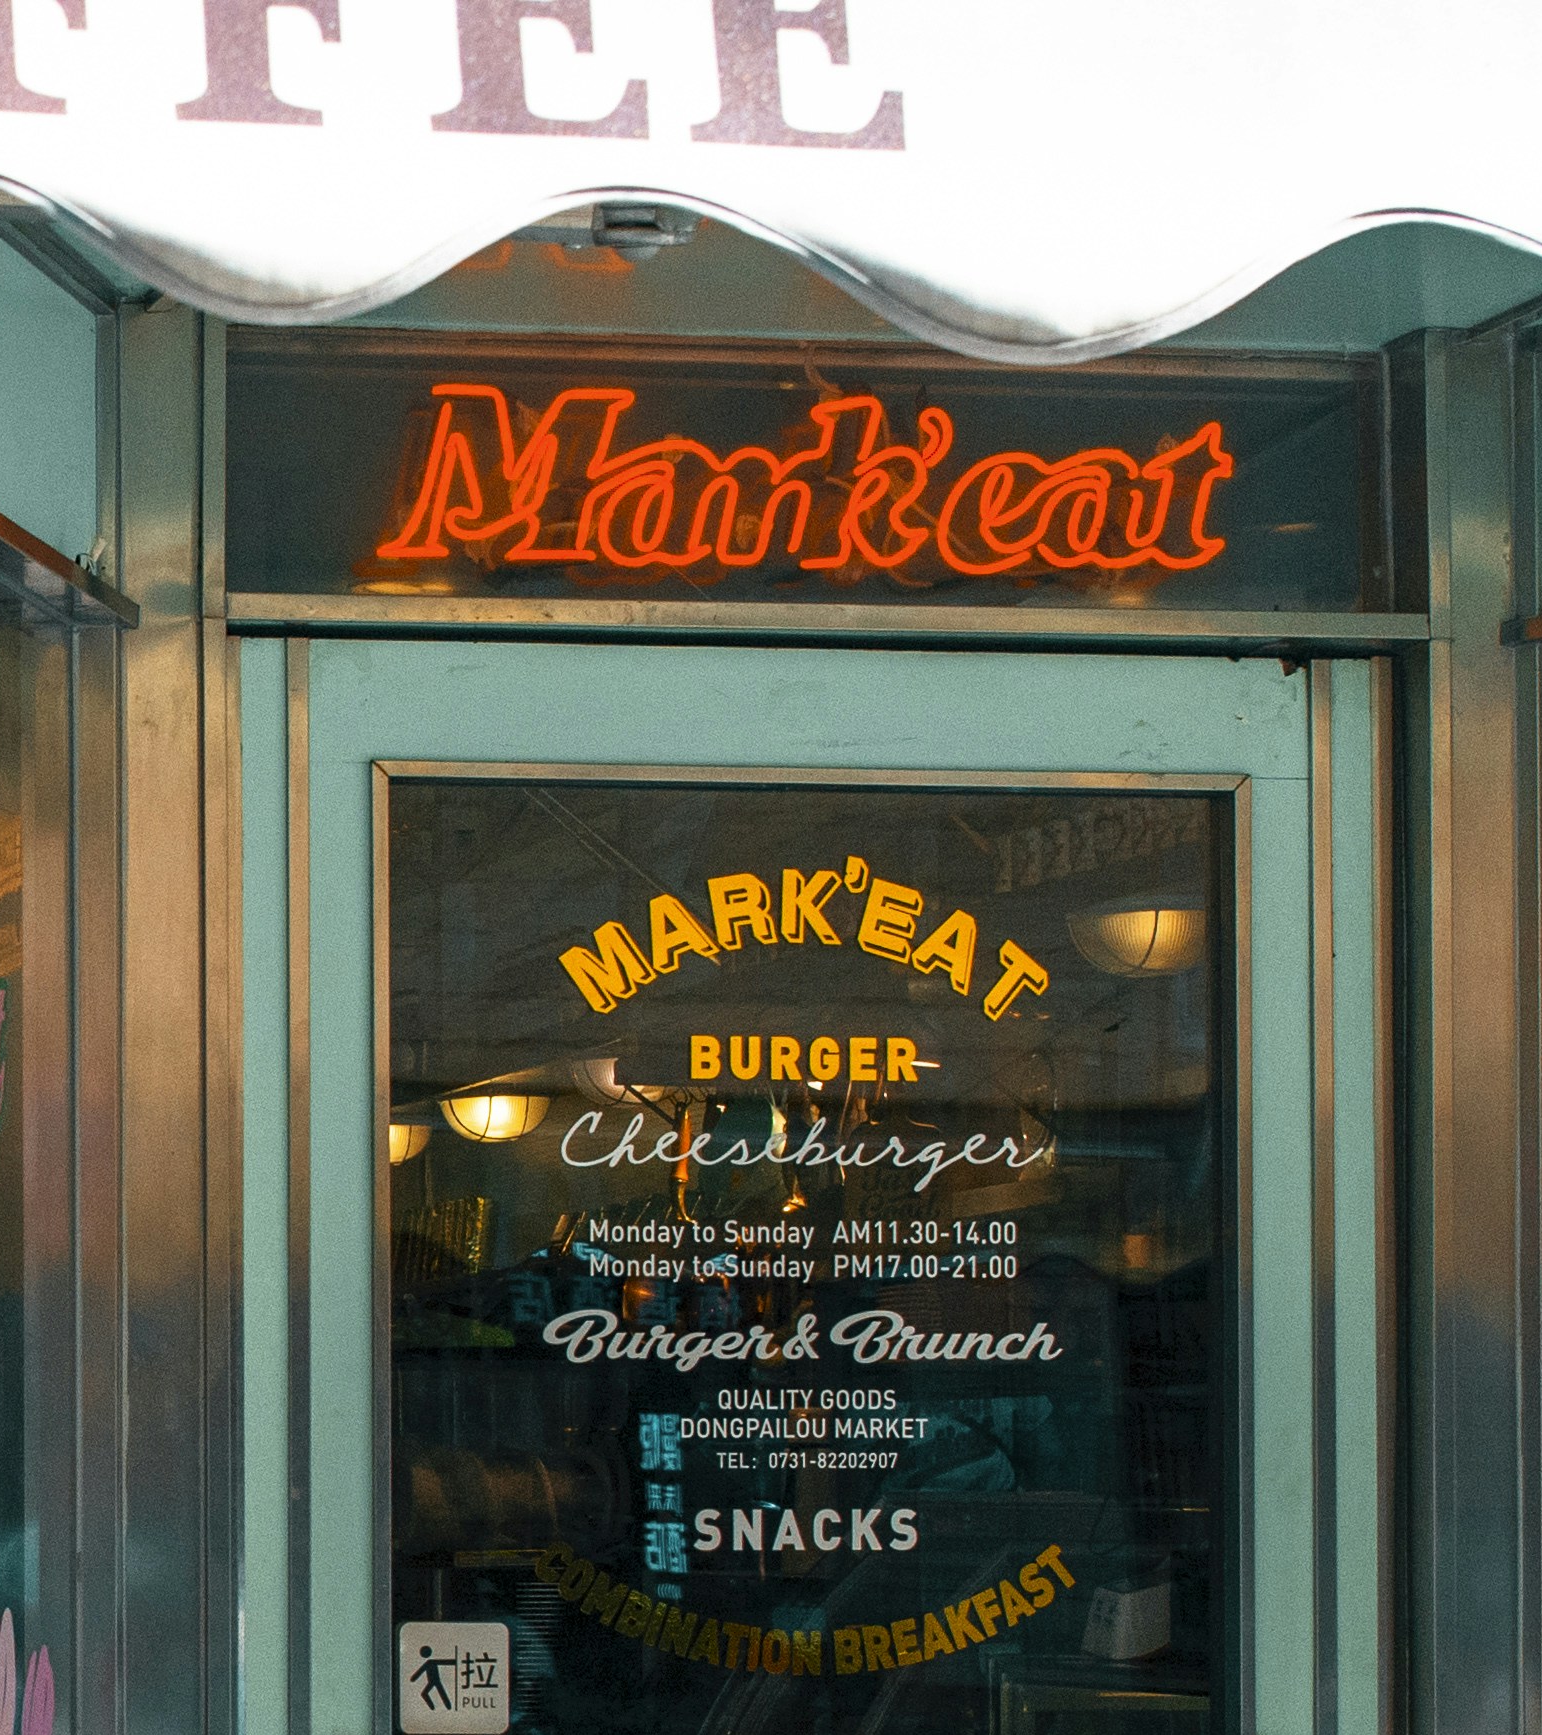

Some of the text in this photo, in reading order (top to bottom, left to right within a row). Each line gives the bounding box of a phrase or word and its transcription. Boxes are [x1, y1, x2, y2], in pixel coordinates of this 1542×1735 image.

[559, 856, 1049, 1022] MARK'EAT
[690, 1035, 918, 1083] BURGER
[560, 1111, 1048, 1192] Cheeseburger
[589, 1219, 1017, 1248] Monday to Sunday AM11.30-14.00
[589, 1253, 1017, 1282] Monday to Sunday PM17.00-21.00
[542, 1308, 1064, 1373] Burger & Brunch
[716, 1389, 897, 1412] QUALITY GOODS
[680, 1417, 929, 1440] DONGPAILOU MARKET
[717, 1451, 898, 1470] TEL: 0731-82202907
[693, 1508, 918, 1552] SNACKS
[534, 1540, 1077, 1677] COMBINATION BREAKFAST
[461, 1650, 499, 1689] 拉
[461, 1695, 497, 1709] PULL
